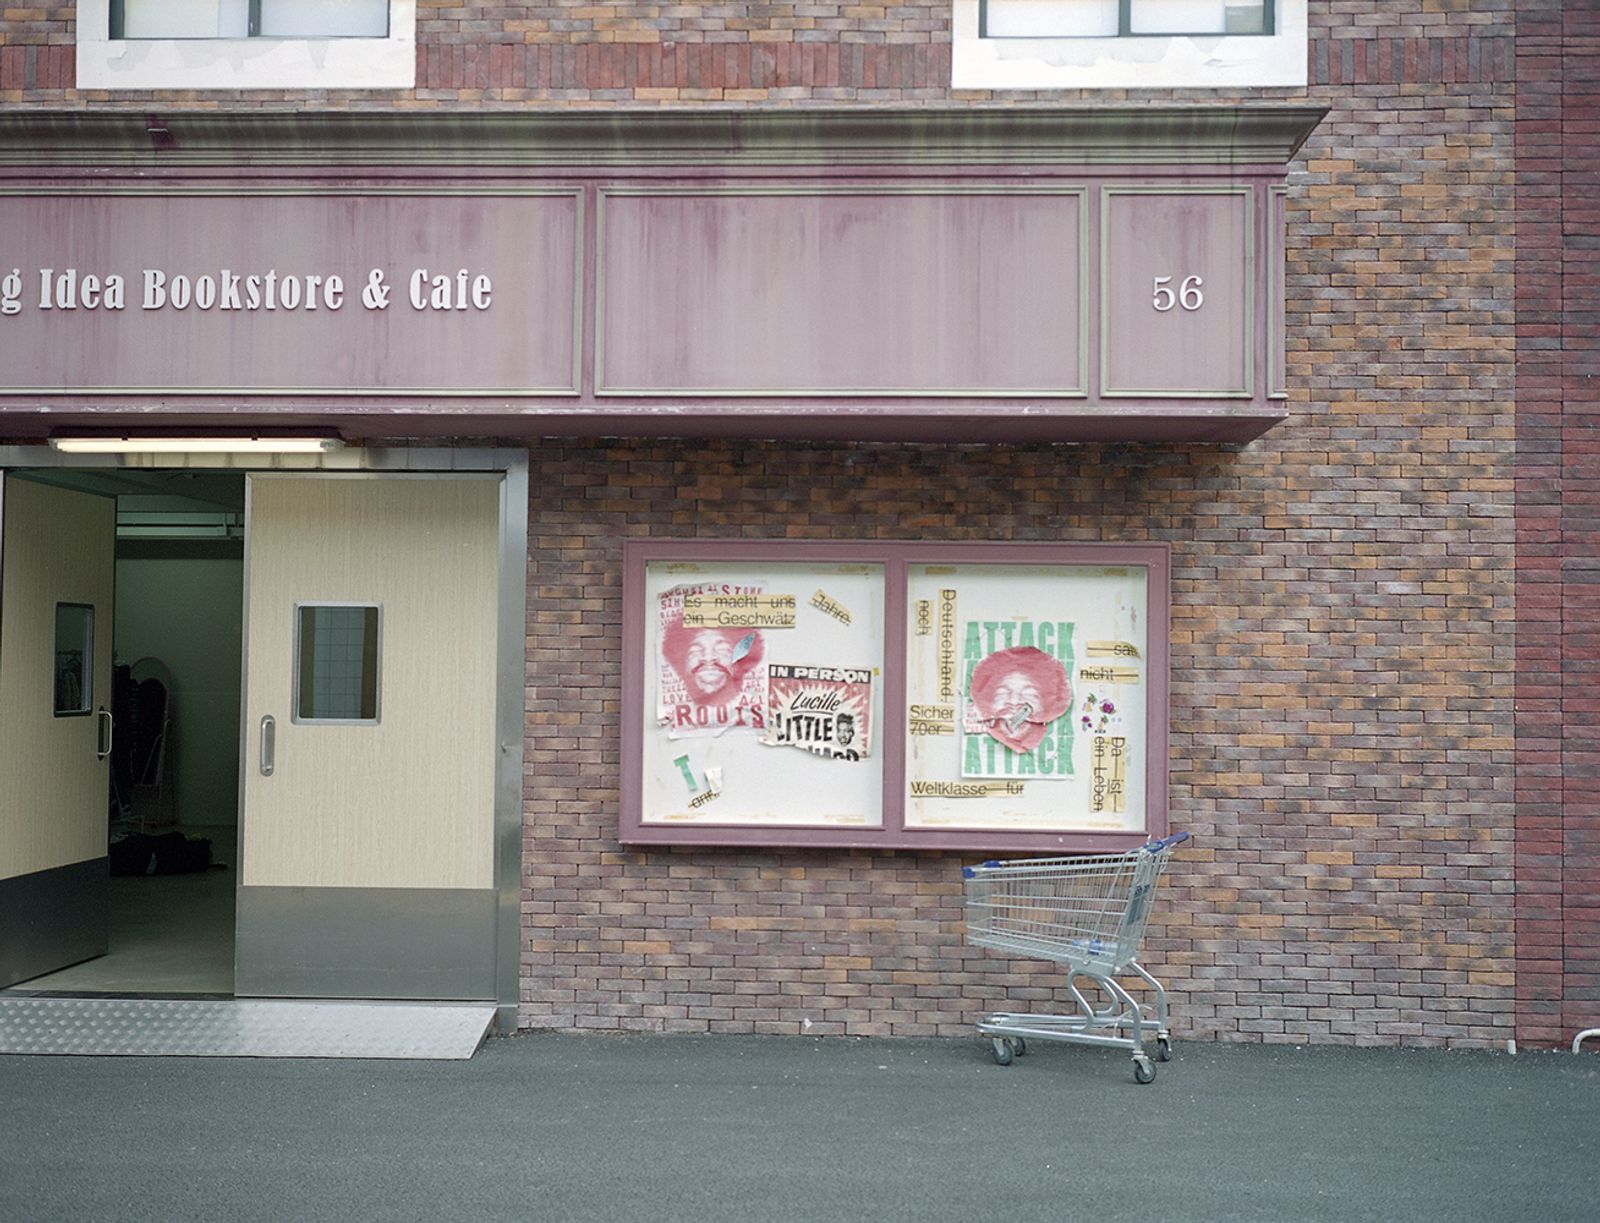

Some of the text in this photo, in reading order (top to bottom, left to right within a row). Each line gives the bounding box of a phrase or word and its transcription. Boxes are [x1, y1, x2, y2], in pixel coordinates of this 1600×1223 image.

[39, 268, 125, 310] Idea
[142, 268, 344, 310] Bookstore
[362, 267, 391, 310] &
[409, 268, 492, 310] Cafe
[1152, 275, 1204, 312] 56
[683, 594, 702, 609] Es
[715, 594, 758, 609] macht
[770, 595, 796, 609] uns
[683, 611, 704, 625] ein
[717, 609, 796, 626] Geschwätz
[965, 621, 1075, 659] ATTACK
[770, 665, 788, 678] IN
[793, 666, 869, 683] PERSON
[1080, 666, 1114, 681] nicht
[790, 691, 841, 712] Lucille
[910, 704, 954, 719] Sicher
[775, 712, 833, 742] LITTLE
[909, 721, 943, 736] 70er
[964, 736, 1075, 774] ATTACK
[1110, 736, 1126, 757] Da
[910, 780, 1024, 796] Weltklasse für
